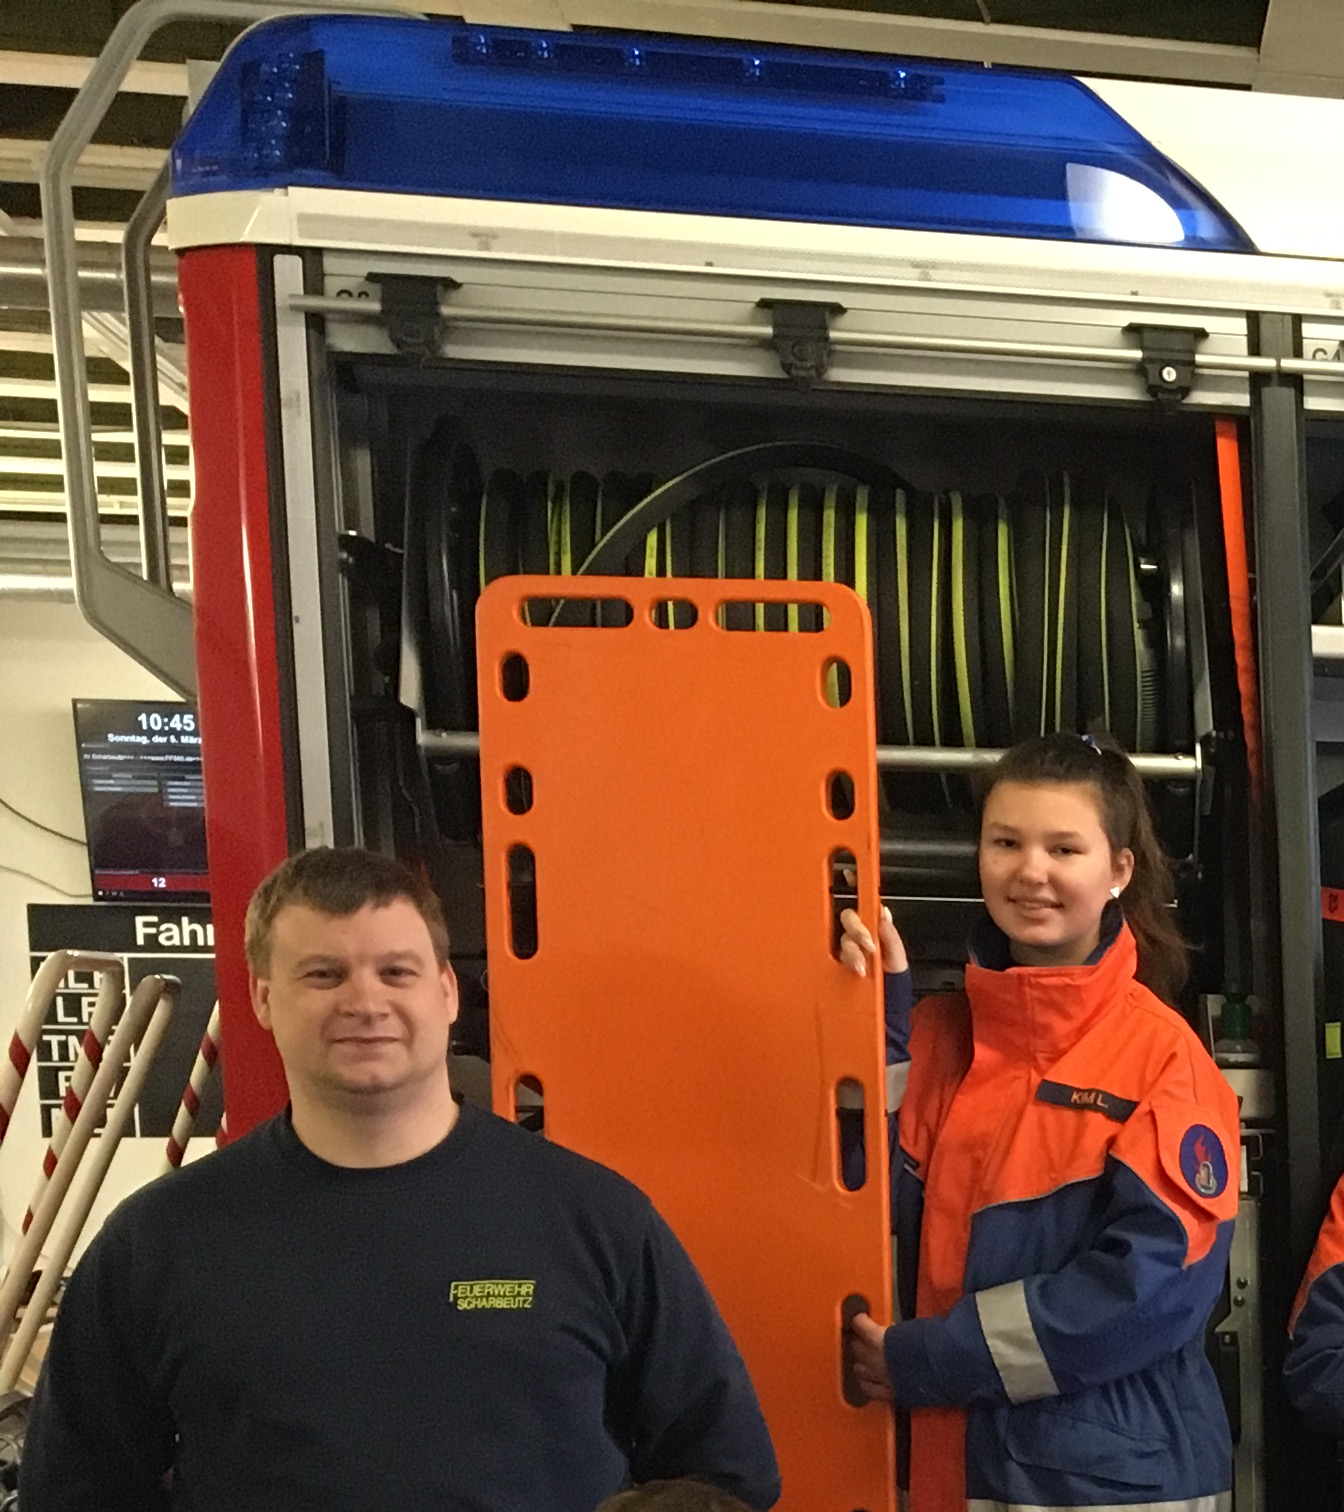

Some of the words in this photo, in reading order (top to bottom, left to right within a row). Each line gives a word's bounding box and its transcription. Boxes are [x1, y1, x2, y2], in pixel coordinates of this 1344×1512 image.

[137, 712, 195, 731] 10:45
[107, 733, 150, 744] Sonntag,
[152, 735, 168, 743] der
[151, 877, 167, 888] 12
[1071, 1090, 1096, 1105] KIM
[449, 1280, 536, 1302] FEUERWEHR
[456, 1296, 533, 1311] SCHARBEUTZ
